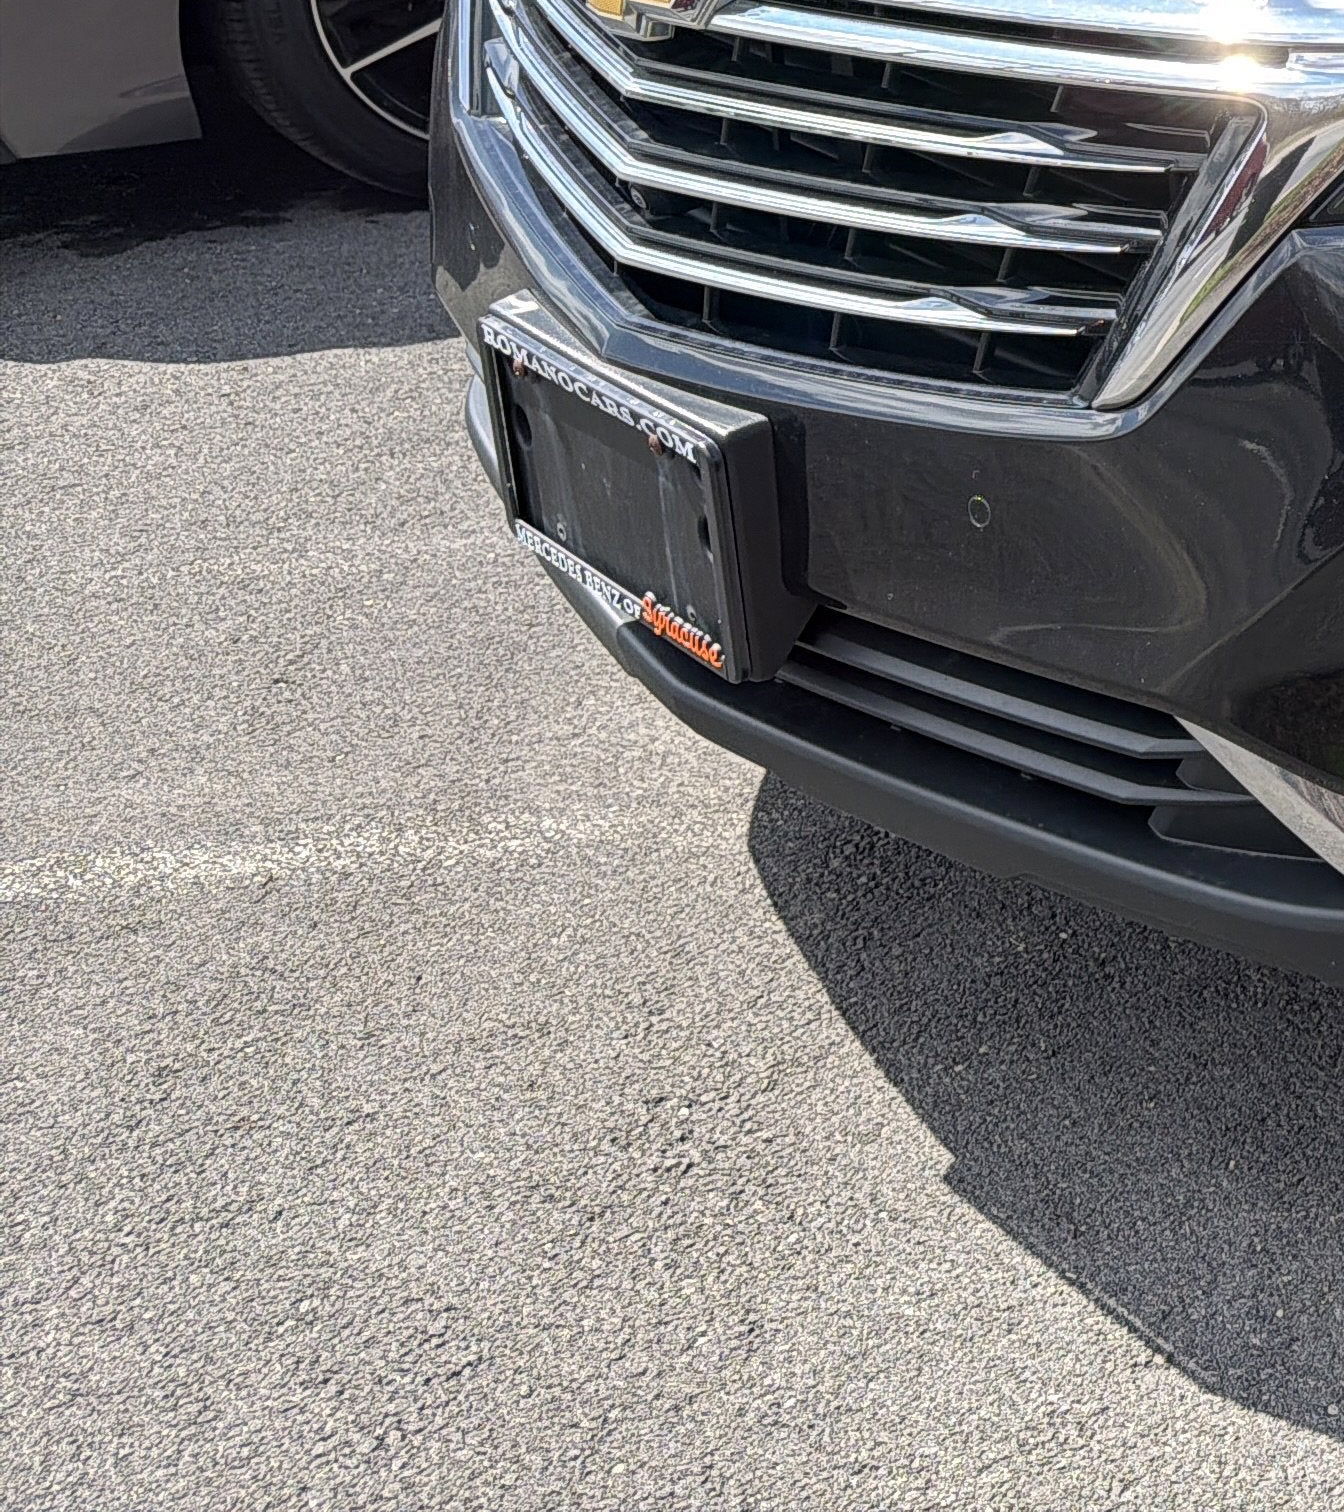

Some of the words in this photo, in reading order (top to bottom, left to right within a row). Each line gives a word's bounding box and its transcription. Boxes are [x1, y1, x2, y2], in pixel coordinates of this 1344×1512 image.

[481, 323, 697, 464] ROMANOCARS.COM
[514, 523, 583, 583] MERCEDES
[584, 569, 623, 611] BENZ
[623, 598, 642, 620] OF
[642, 591, 726, 668] Syracuse
